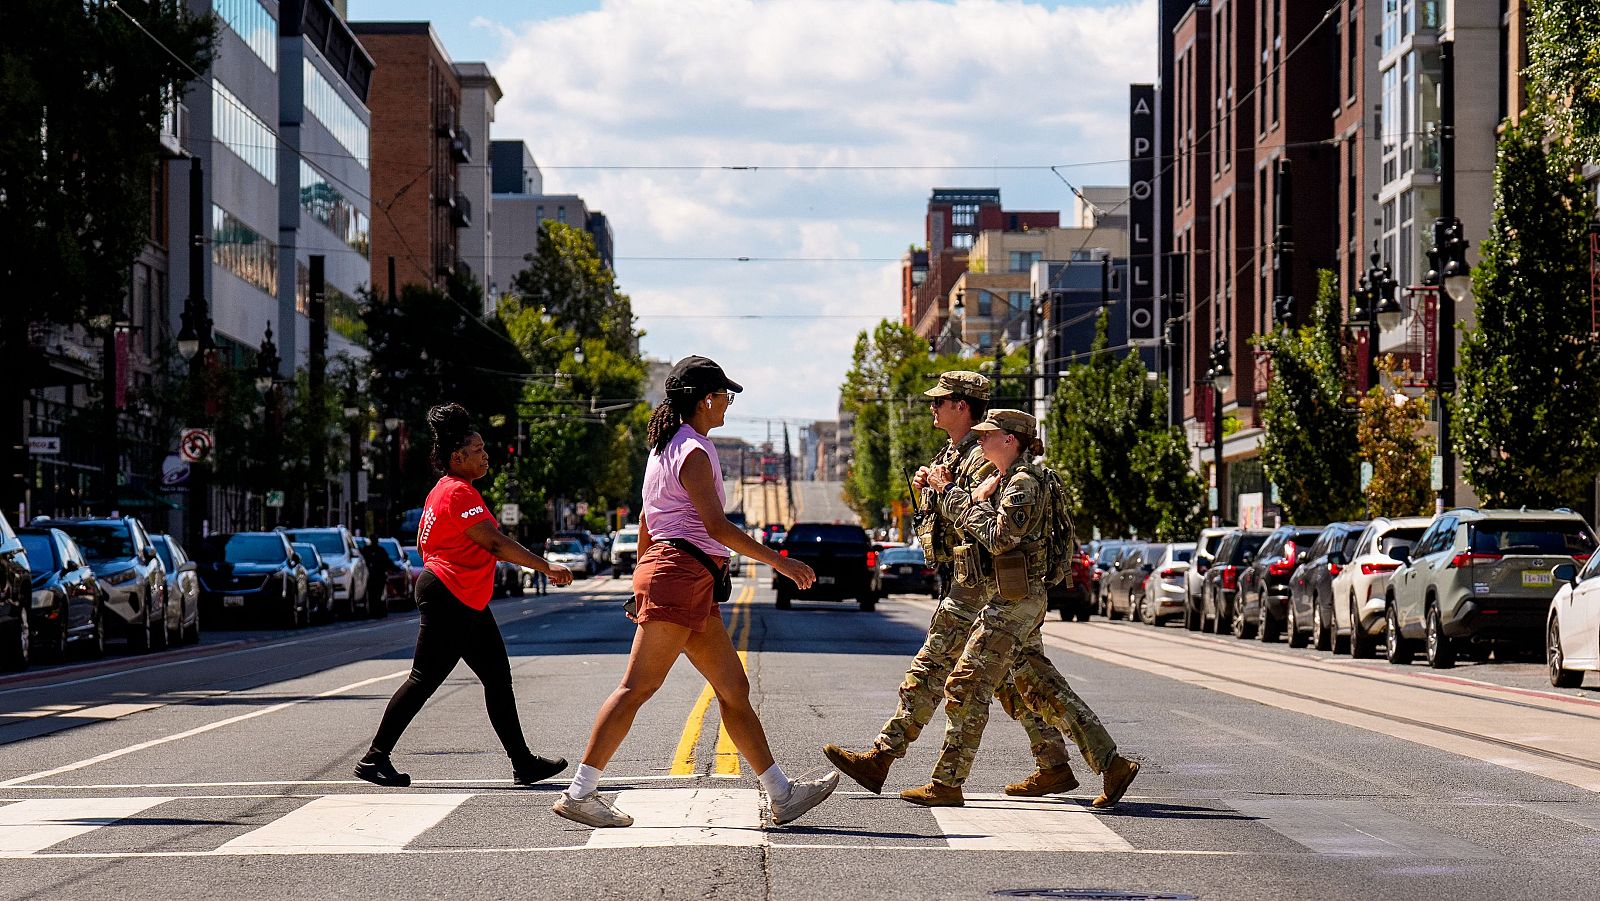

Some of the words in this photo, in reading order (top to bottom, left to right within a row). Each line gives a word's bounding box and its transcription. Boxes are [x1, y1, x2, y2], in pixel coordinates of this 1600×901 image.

[1132, 97, 1151, 328] APOLLO
[1010, 494, 1025, 503] MP
[468, 506, 484, 516] CVS
